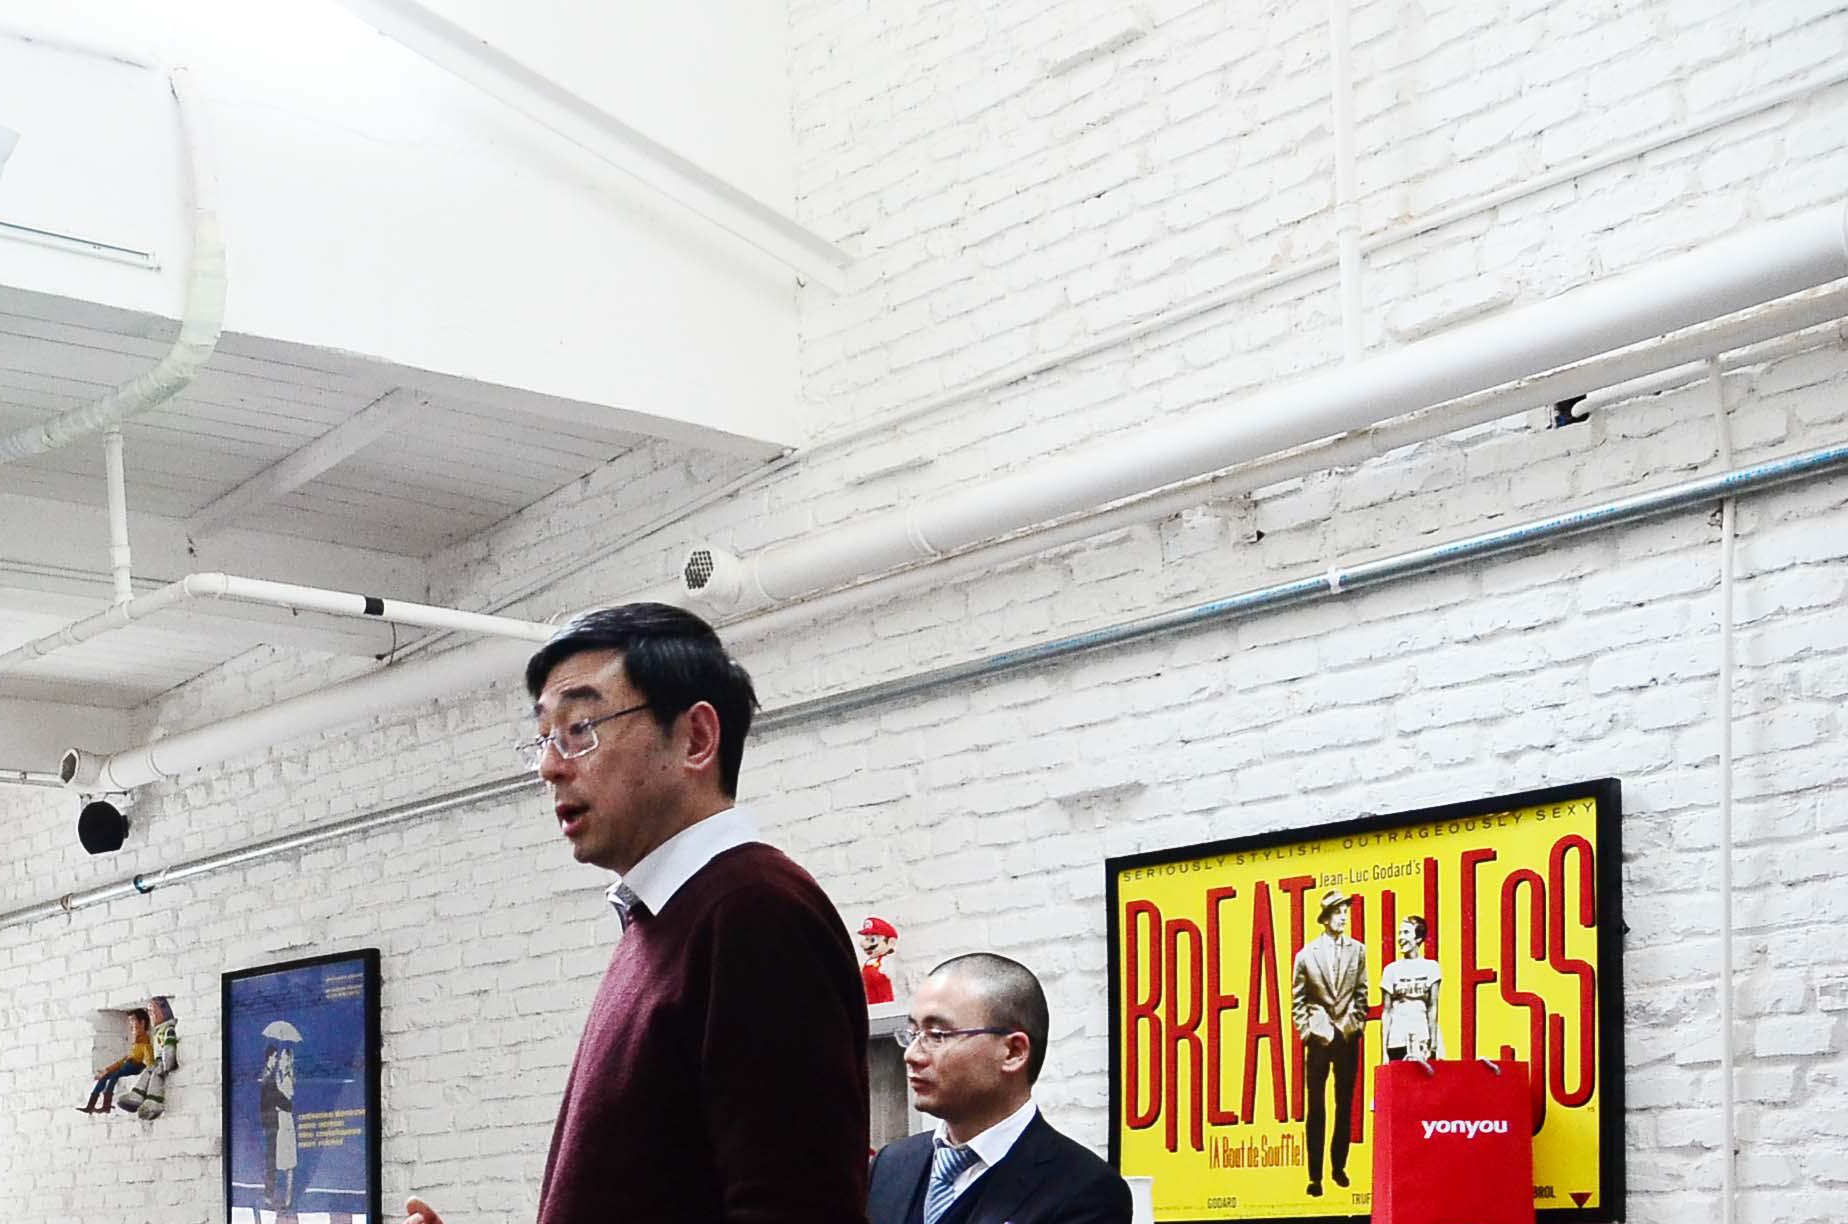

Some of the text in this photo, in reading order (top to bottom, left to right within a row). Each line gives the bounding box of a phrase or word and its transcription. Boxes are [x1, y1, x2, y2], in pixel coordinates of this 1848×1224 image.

[1123, 858, 1226, 883] SERIOUSLY
[1342, 812, 1523, 850] OUTRAGEOUSLY
[1535, 802, 1594, 821] SEXY
[1318, 859, 1421, 889] Jean-Luc Godard's
[1421, 1119, 1509, 1140] yonyou
[1247, 1136, 1259, 1168] de
[1207, 1196, 1237, 1209] GODARD
